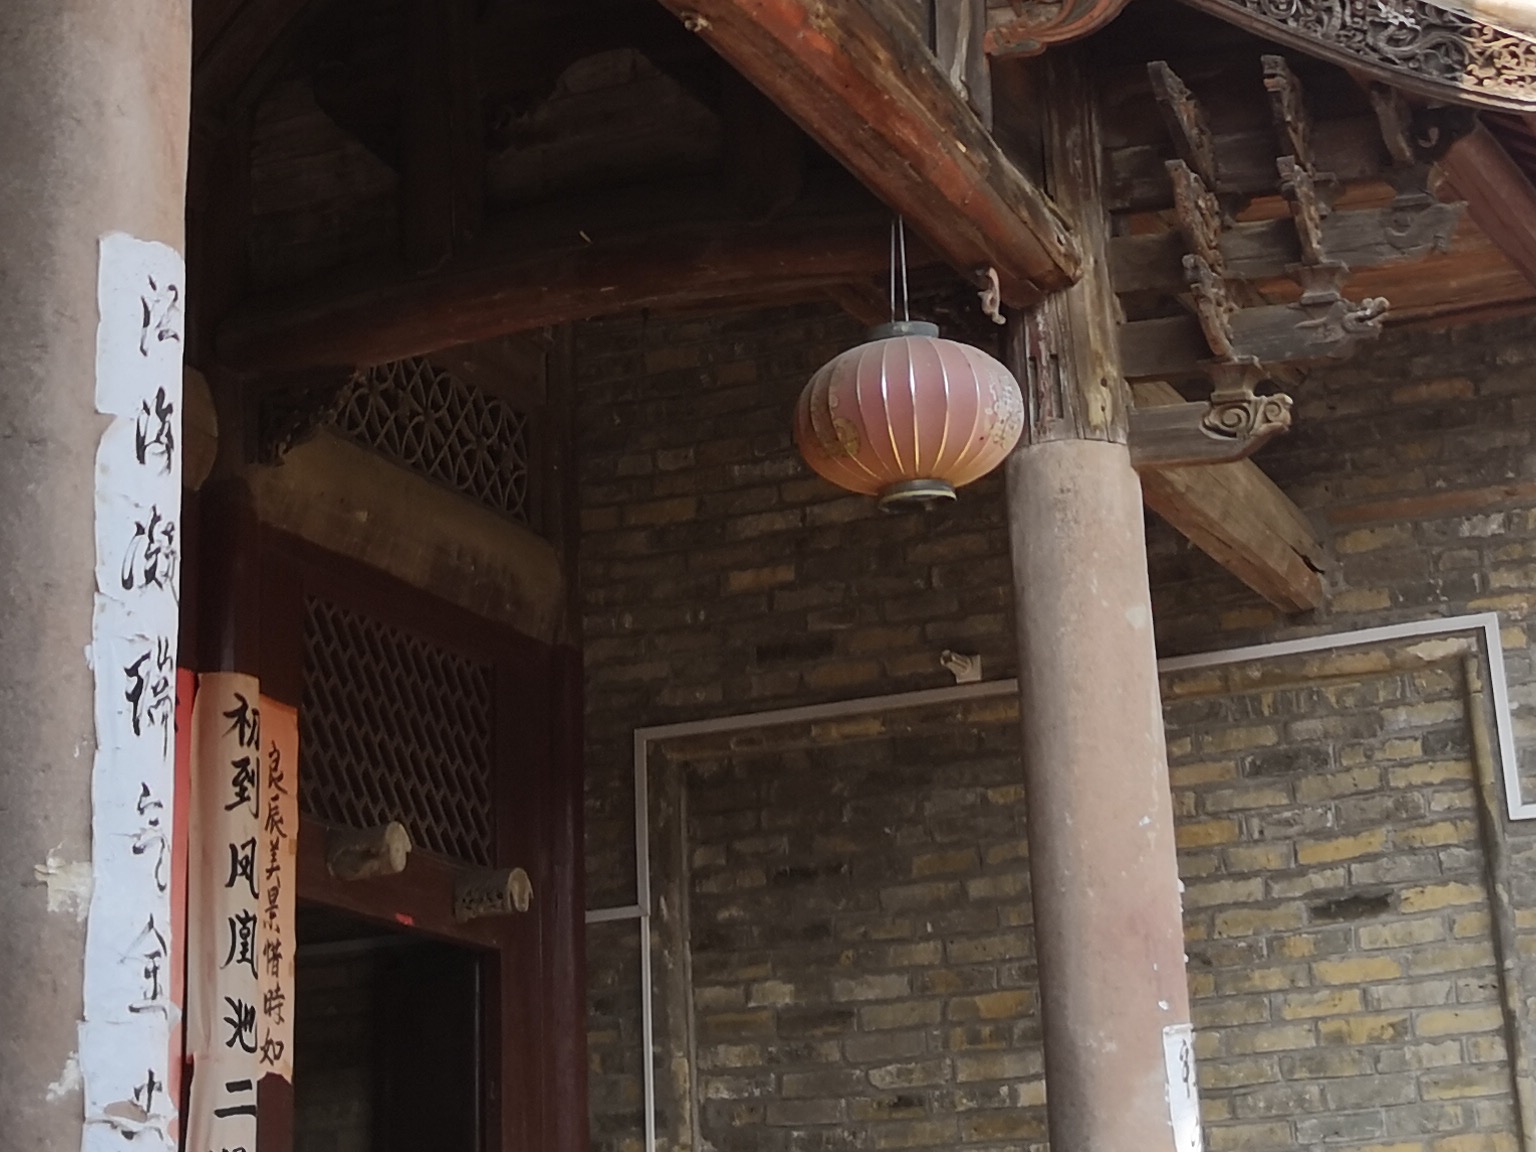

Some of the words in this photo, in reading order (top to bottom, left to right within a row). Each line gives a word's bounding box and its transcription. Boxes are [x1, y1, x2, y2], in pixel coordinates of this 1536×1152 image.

[214, 692, 260, 1152] 初到凤凰池二
